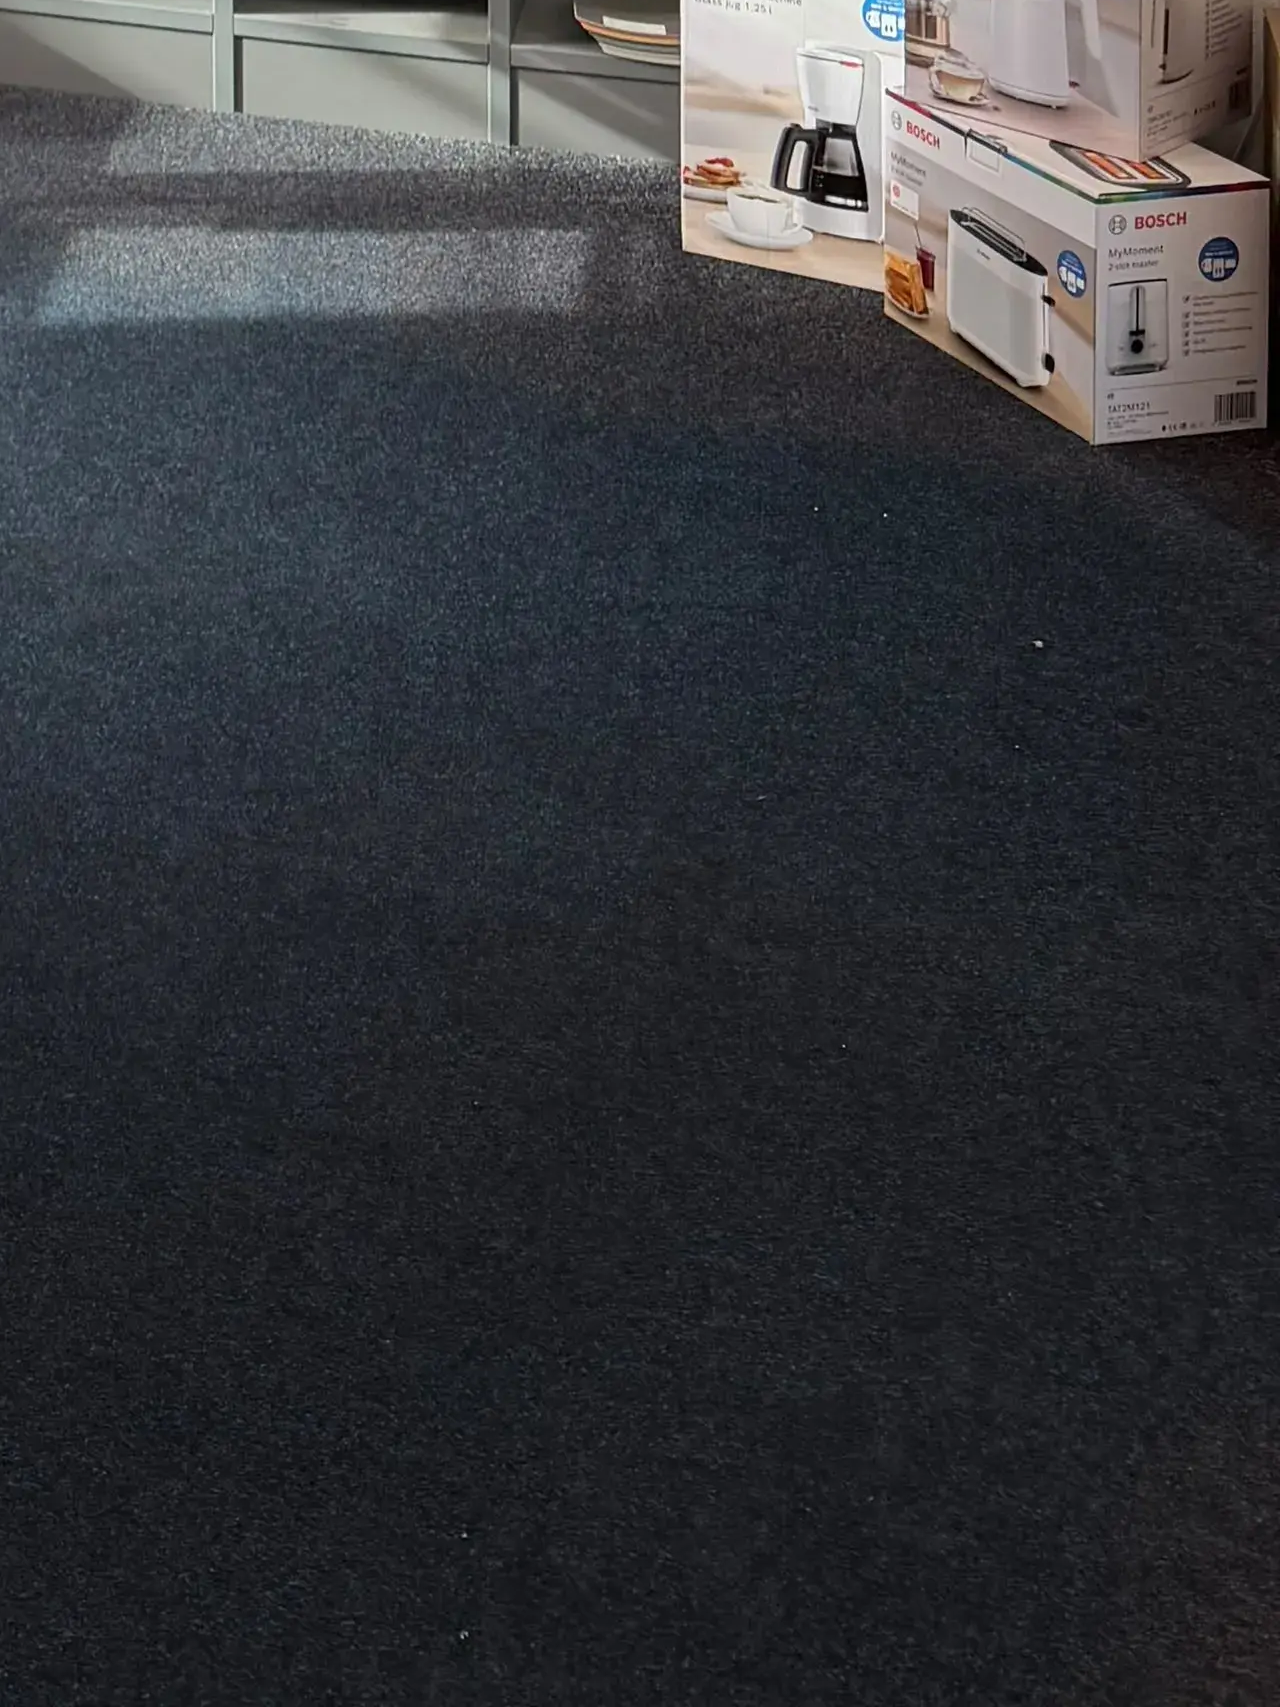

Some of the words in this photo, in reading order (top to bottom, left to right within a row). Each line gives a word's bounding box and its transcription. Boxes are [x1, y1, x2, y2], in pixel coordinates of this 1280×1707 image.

[906, 120, 940, 149] BOSCH
[1134, 212, 1187, 230] BOSCH
[1108, 244, 1164, 261] MyMoment
